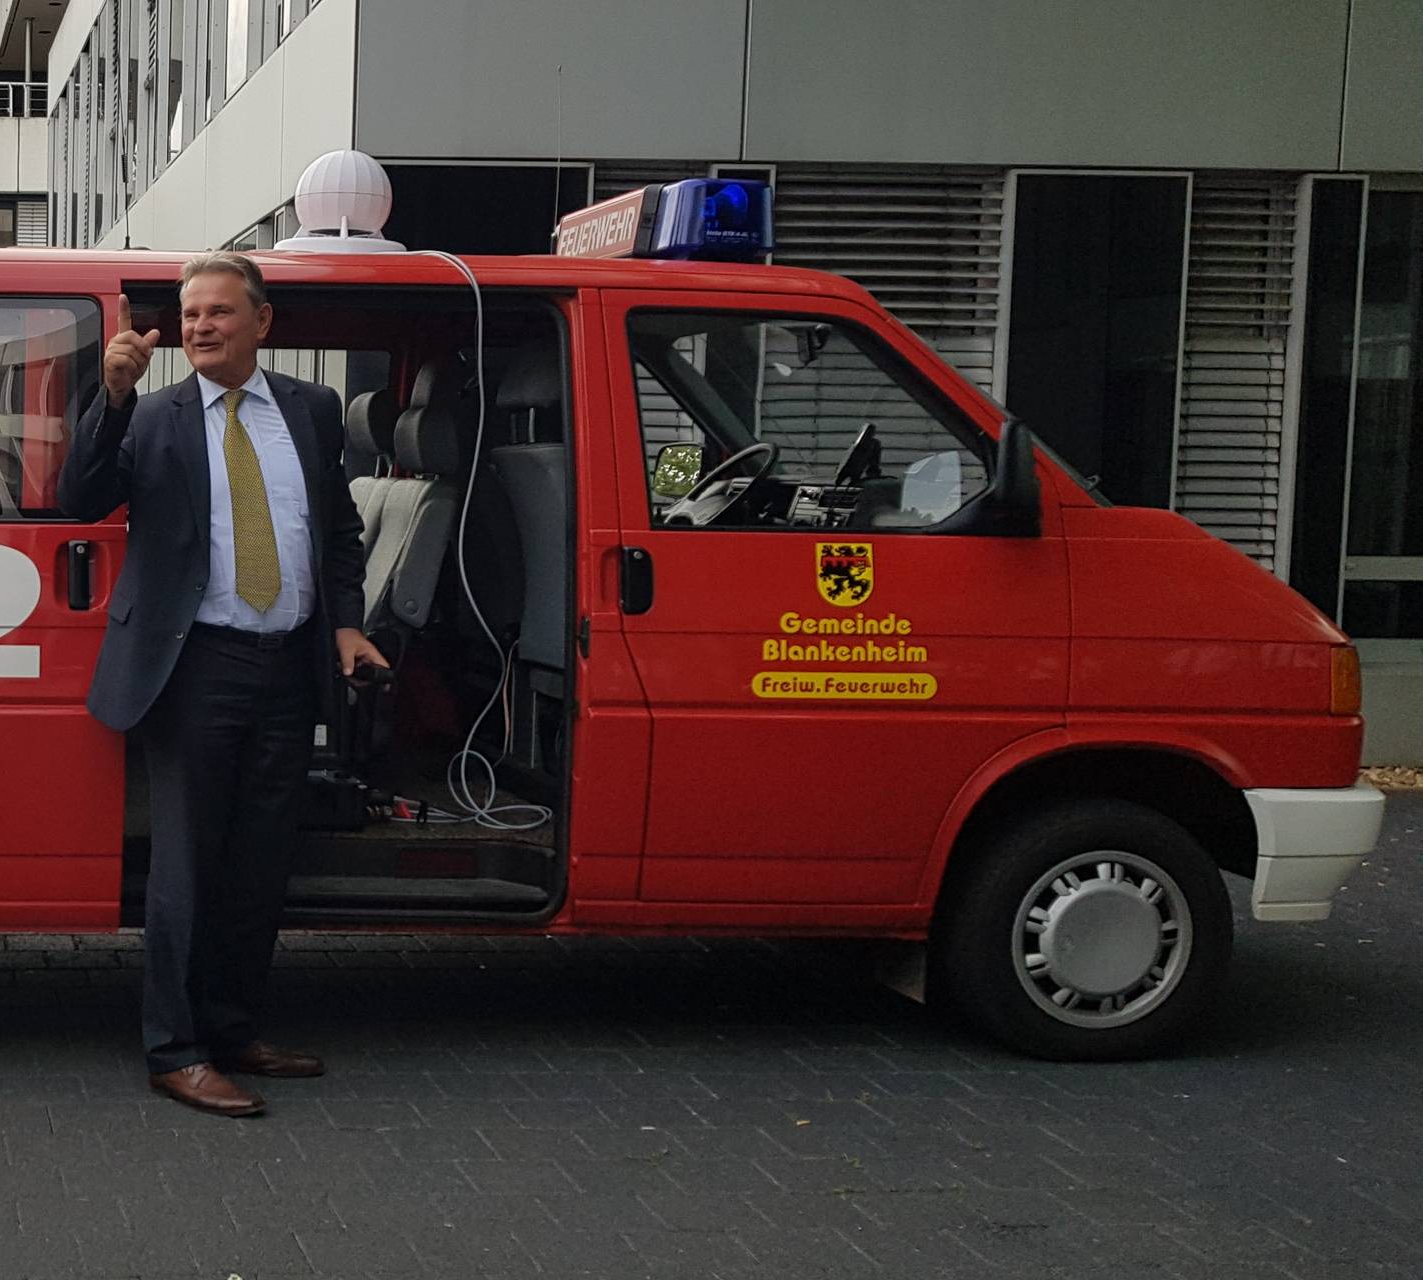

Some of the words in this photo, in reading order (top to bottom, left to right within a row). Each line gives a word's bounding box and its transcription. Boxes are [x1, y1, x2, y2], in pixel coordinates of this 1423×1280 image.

[557, 206, 636, 256] FEUERWEHR
[780, 612, 912, 634] Gemeinde
[762, 639, 927, 662] Blankenheim
